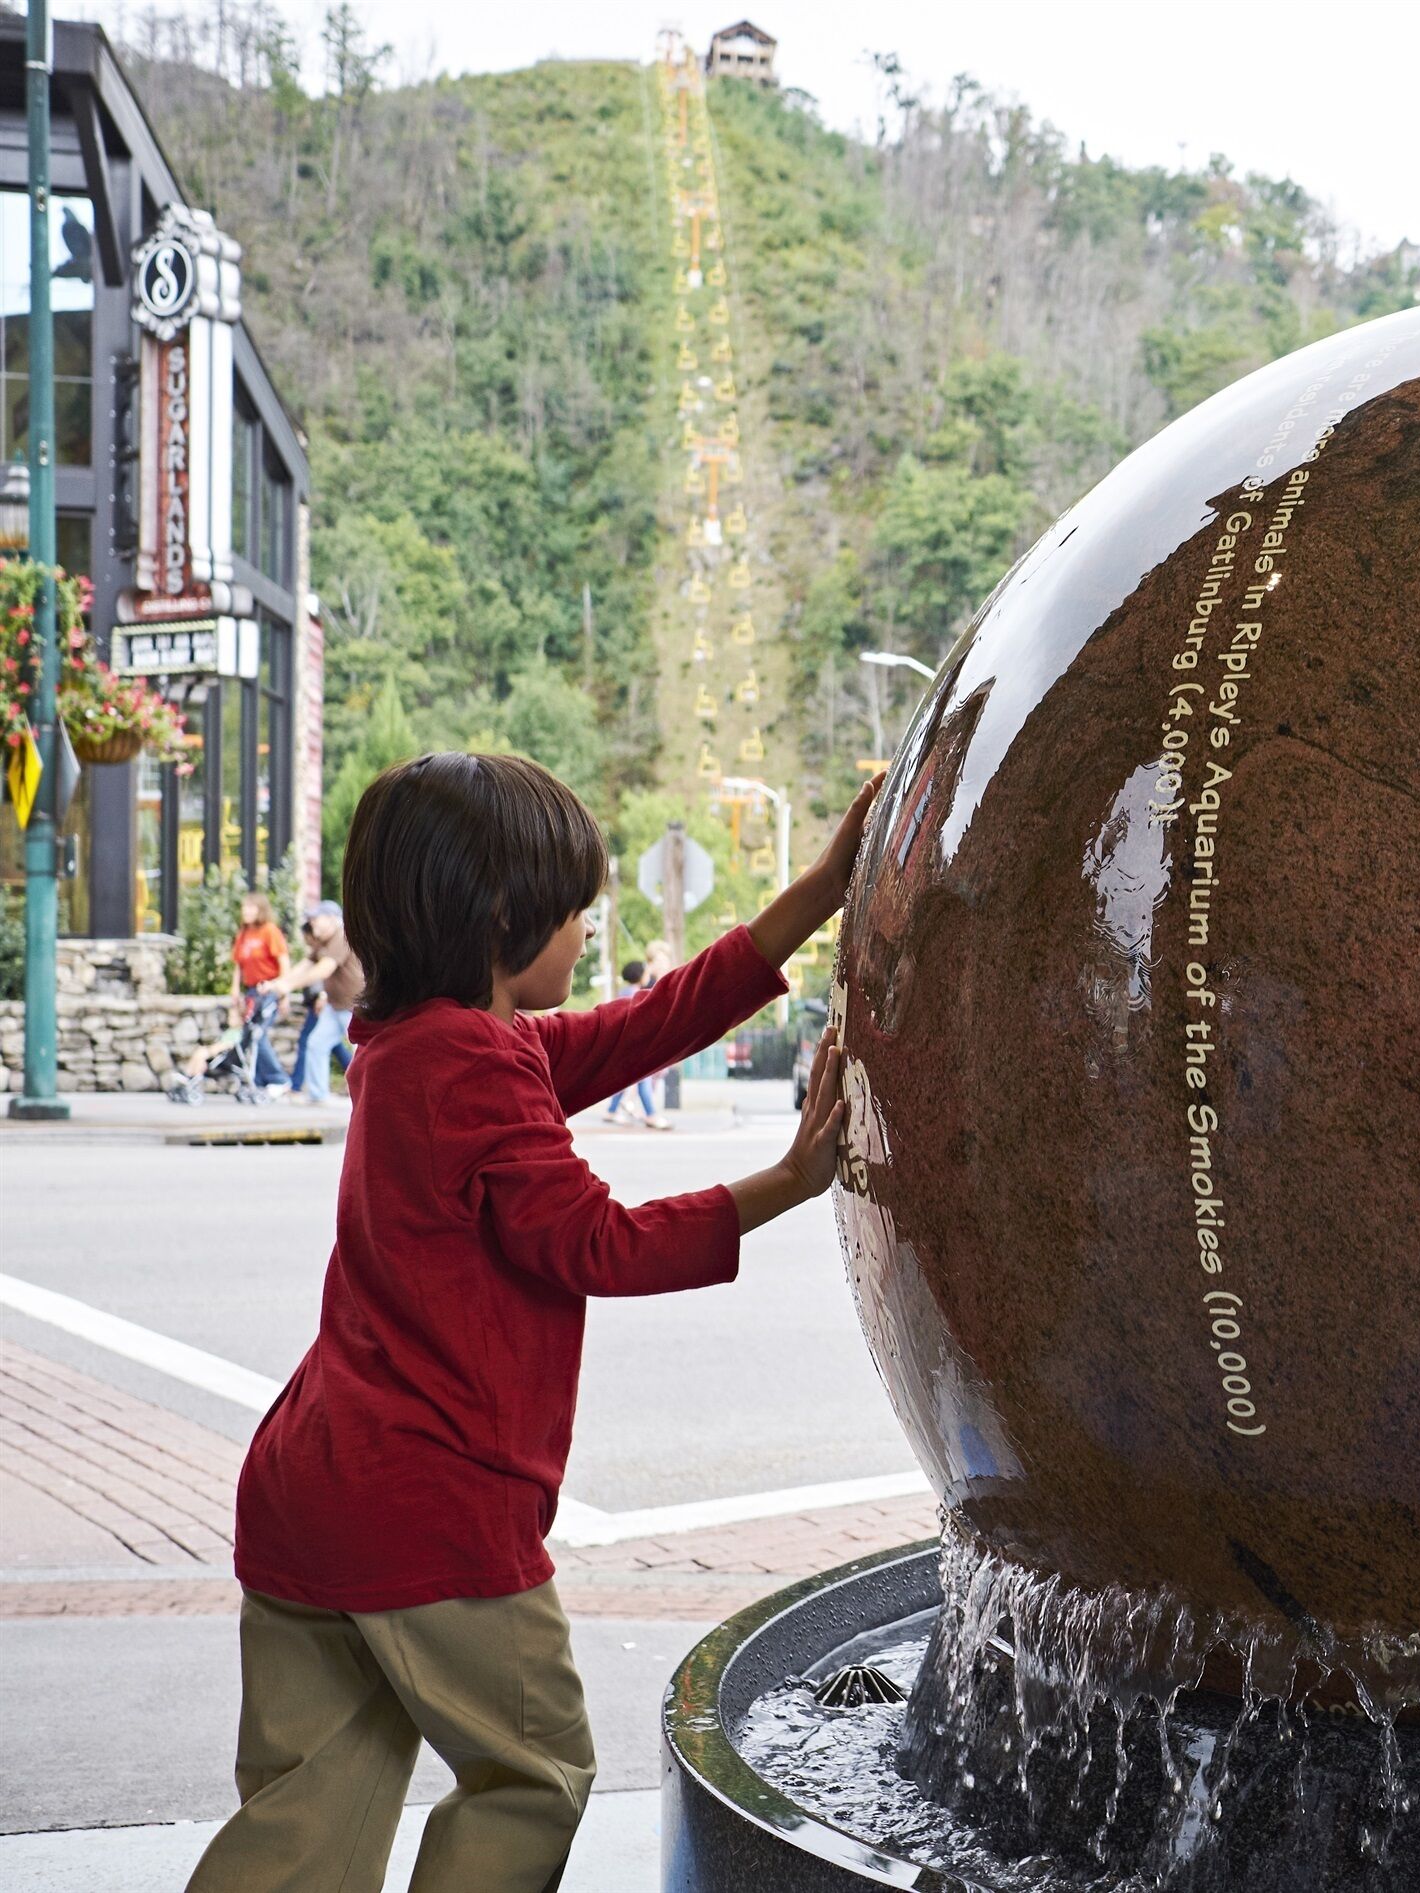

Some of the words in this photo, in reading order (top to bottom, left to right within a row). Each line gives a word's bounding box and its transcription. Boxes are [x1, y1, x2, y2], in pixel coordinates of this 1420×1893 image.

[166, 346, 187, 594] SUGARLANDS
[1239, 474, 1265, 503] of
[1255, 470, 1310, 574] animals
[1172, 511, 1253, 670] Gatlinburg
[1245, 584, 1265, 610] in
[1209, 622, 1263, 748] Ripley's
[1188, 761, 1233, 945] Aquarium
[1186, 961, 1216, 1009] of
[1185, 1019, 1215, 1089] the
[1187, 1104, 1225, 1274] Smokies
[1203, 1291, 1267, 1435] (10,000)
